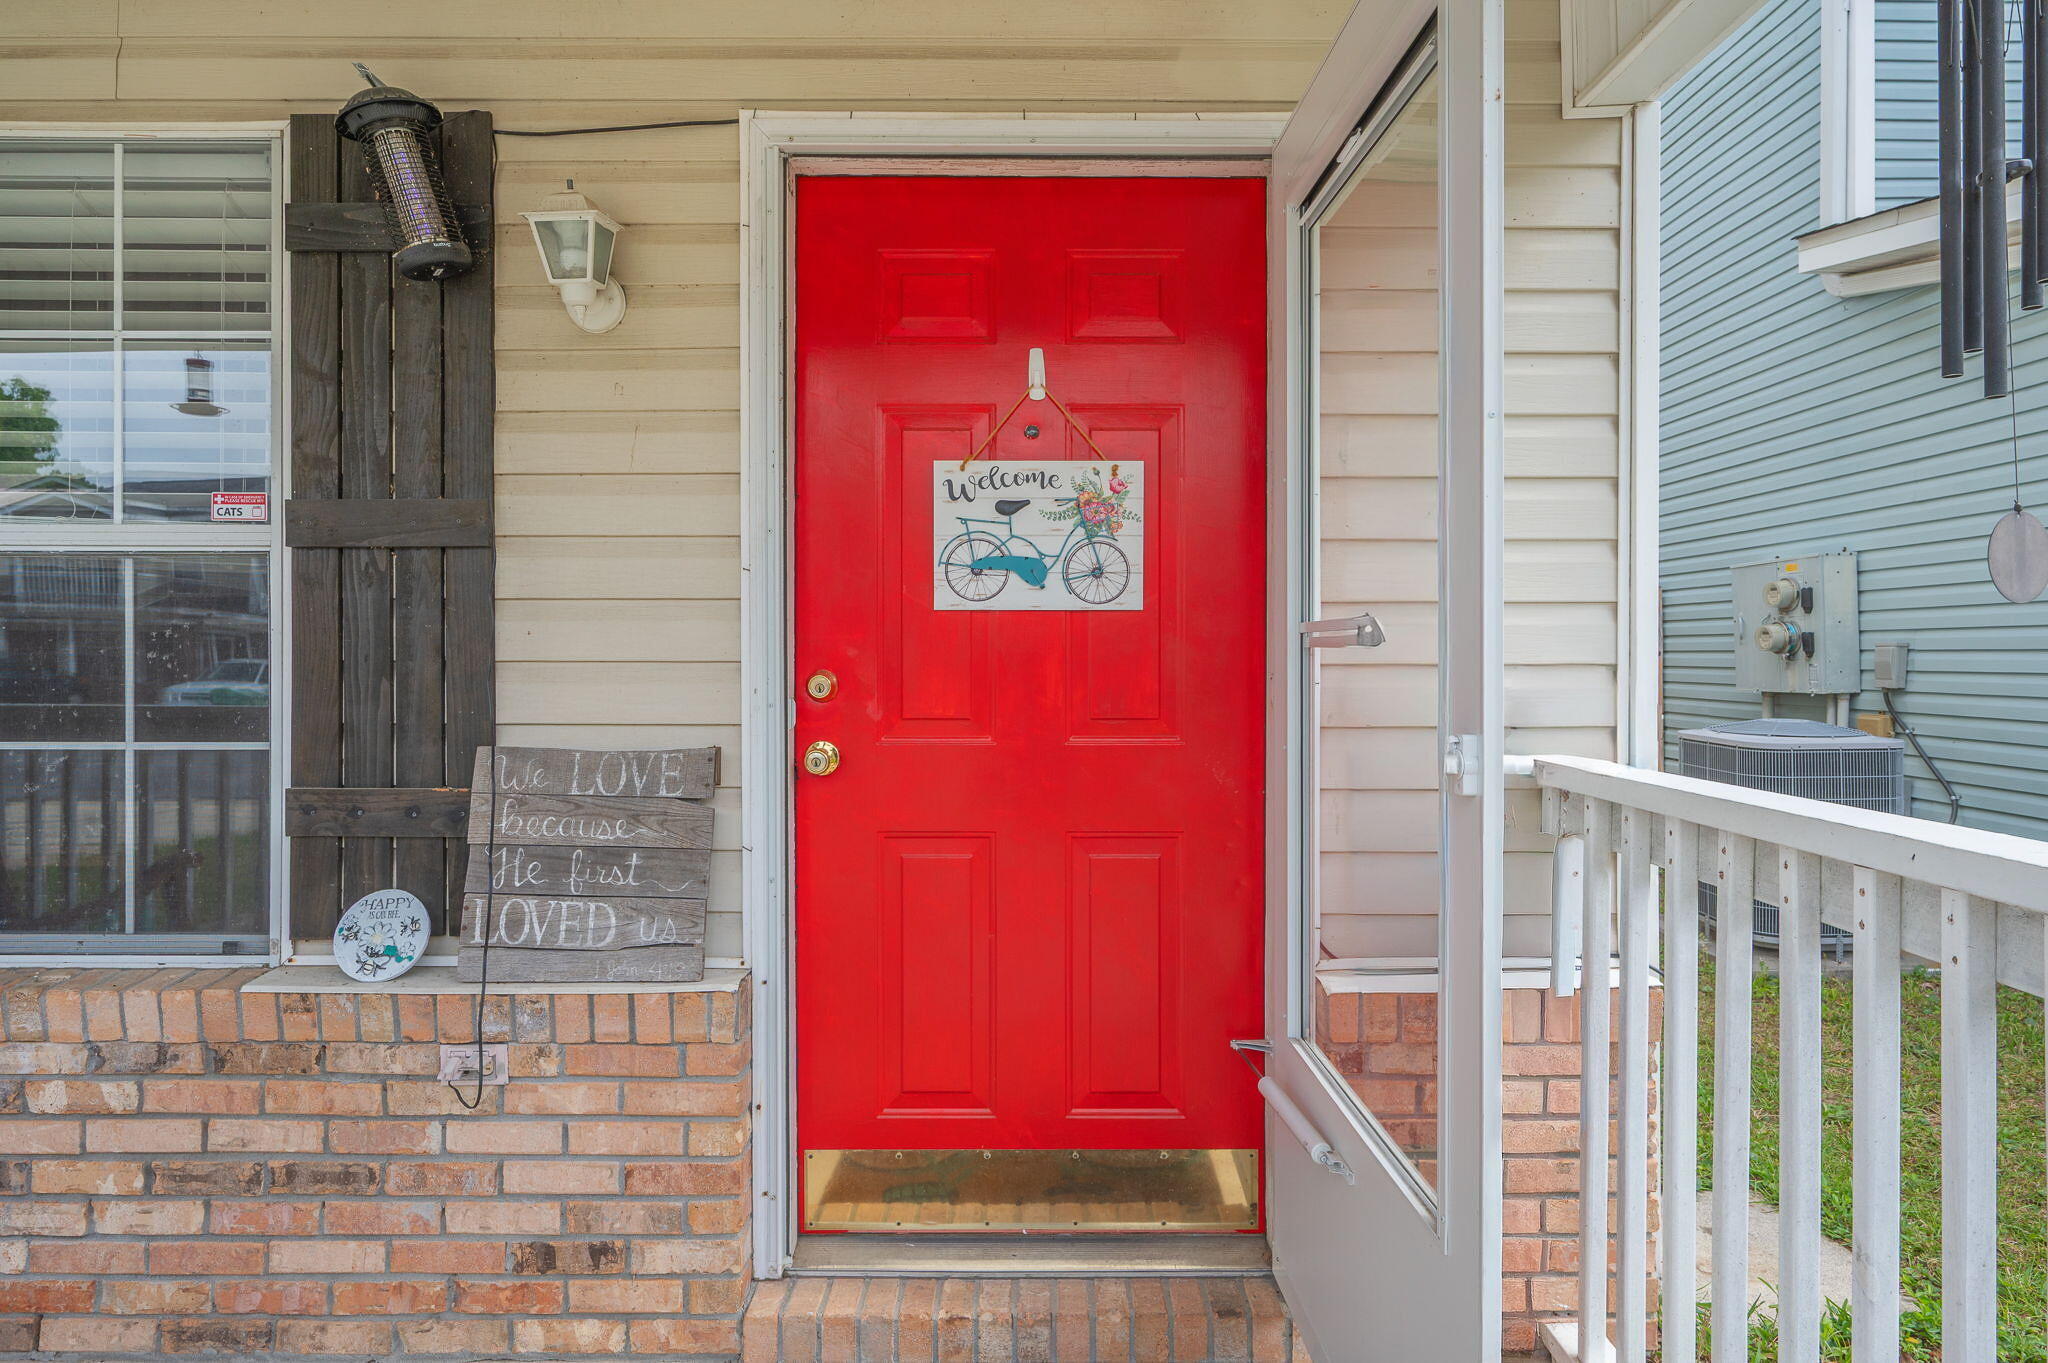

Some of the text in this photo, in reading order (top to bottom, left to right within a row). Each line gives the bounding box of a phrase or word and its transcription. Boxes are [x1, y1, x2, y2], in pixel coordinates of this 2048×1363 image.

[942, 466, 1063, 503] Welcome
[217, 507, 243, 517] CATS
[488, 752, 686, 797] We LOVE
[492, 798, 658, 840] because
[485, 847, 662, 895] He first
[360, 896, 415, 911] HAPPY
[470, 898, 688, 948] LOVED us
